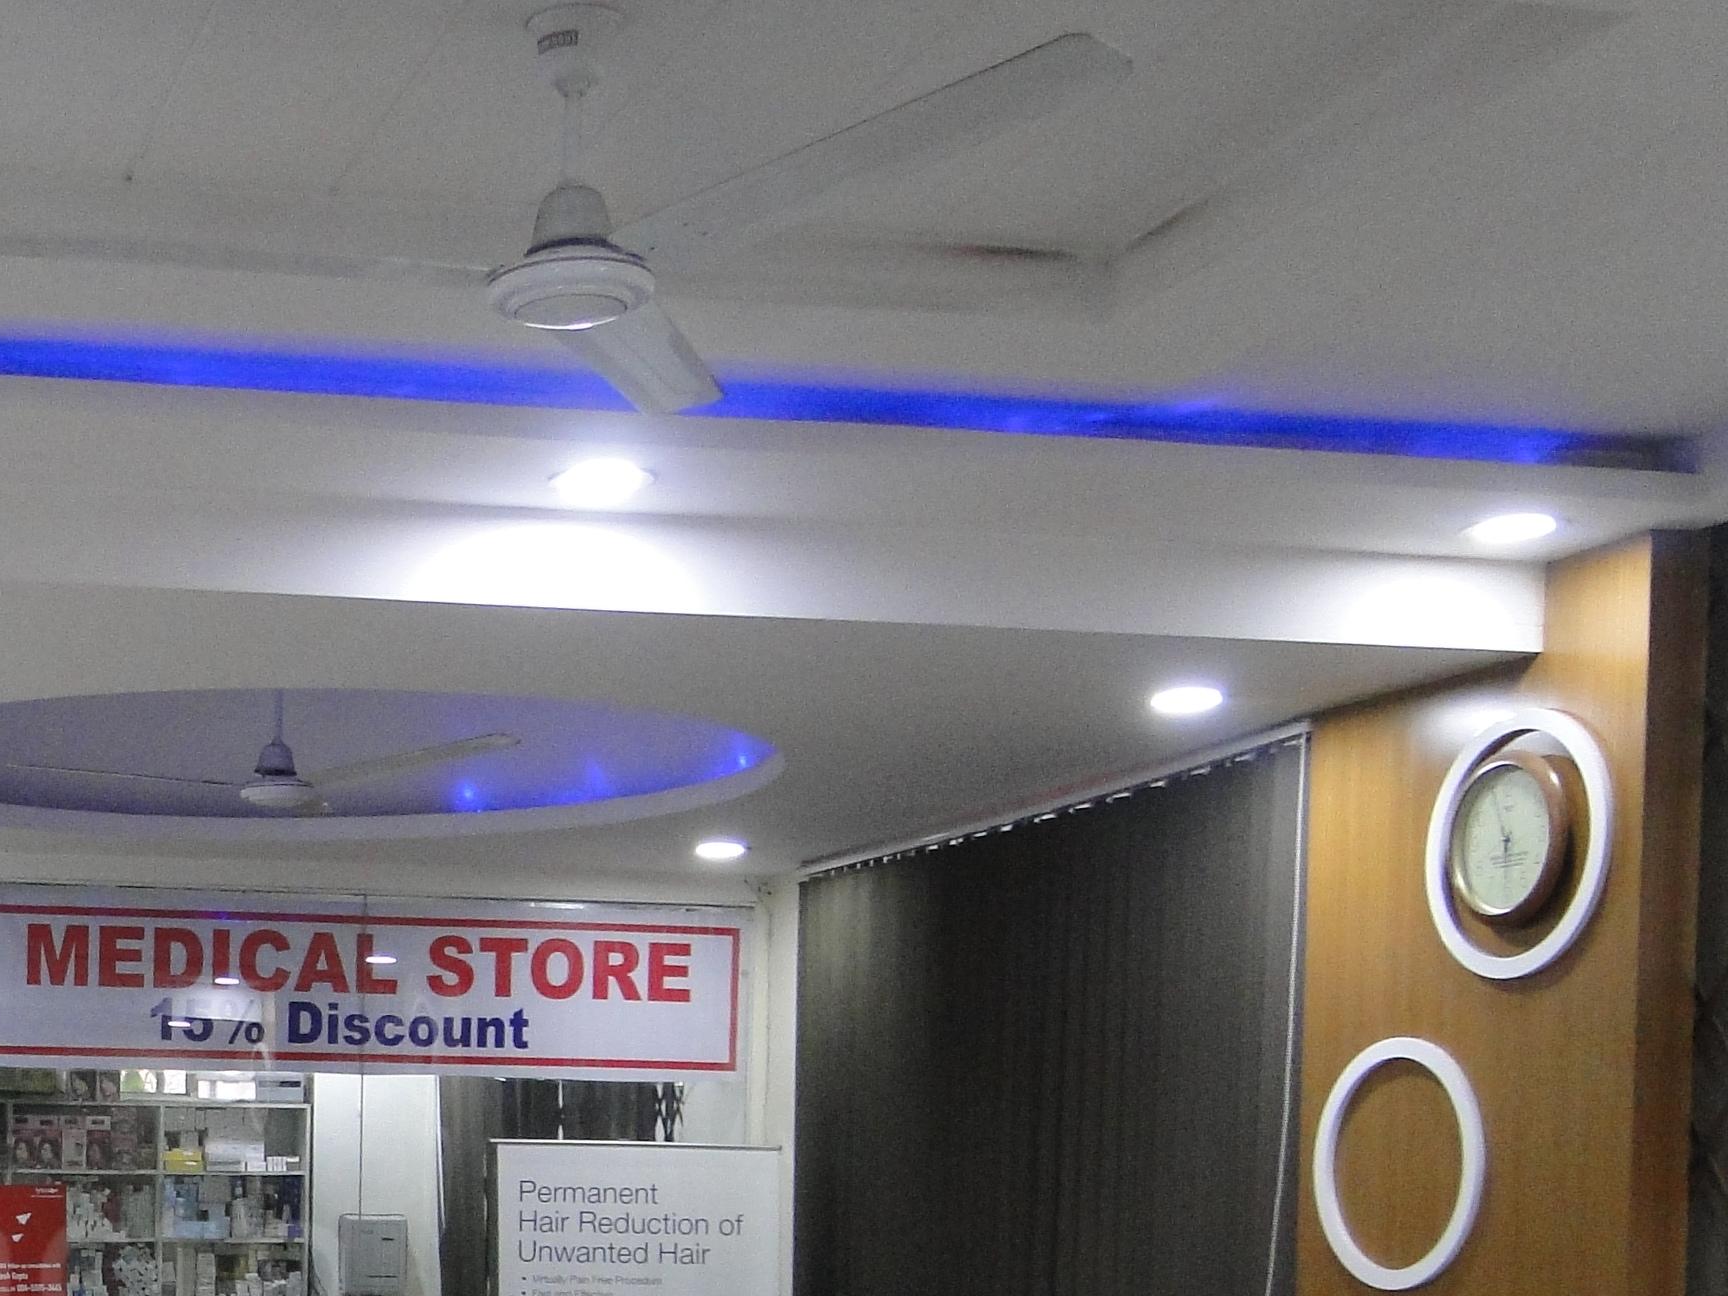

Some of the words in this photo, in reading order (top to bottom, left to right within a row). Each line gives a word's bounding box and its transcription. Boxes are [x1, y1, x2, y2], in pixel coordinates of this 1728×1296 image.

[25, 922, 398, 996] MEDICAL
[426, 934, 693, 1002] STORE
[149, 997, 266, 1045] 15%
[287, 1001, 530, 1050] Discount
[518, 1180, 659, 1205] Permanent
[518, 1210, 571, 1234] Hair
[578, 1211, 710, 1236] Reduction
[718, 1214, 745, 1237] of
[518, 1240, 649, 1265] Unwanted
[658, 1243, 711, 1266] Hair
